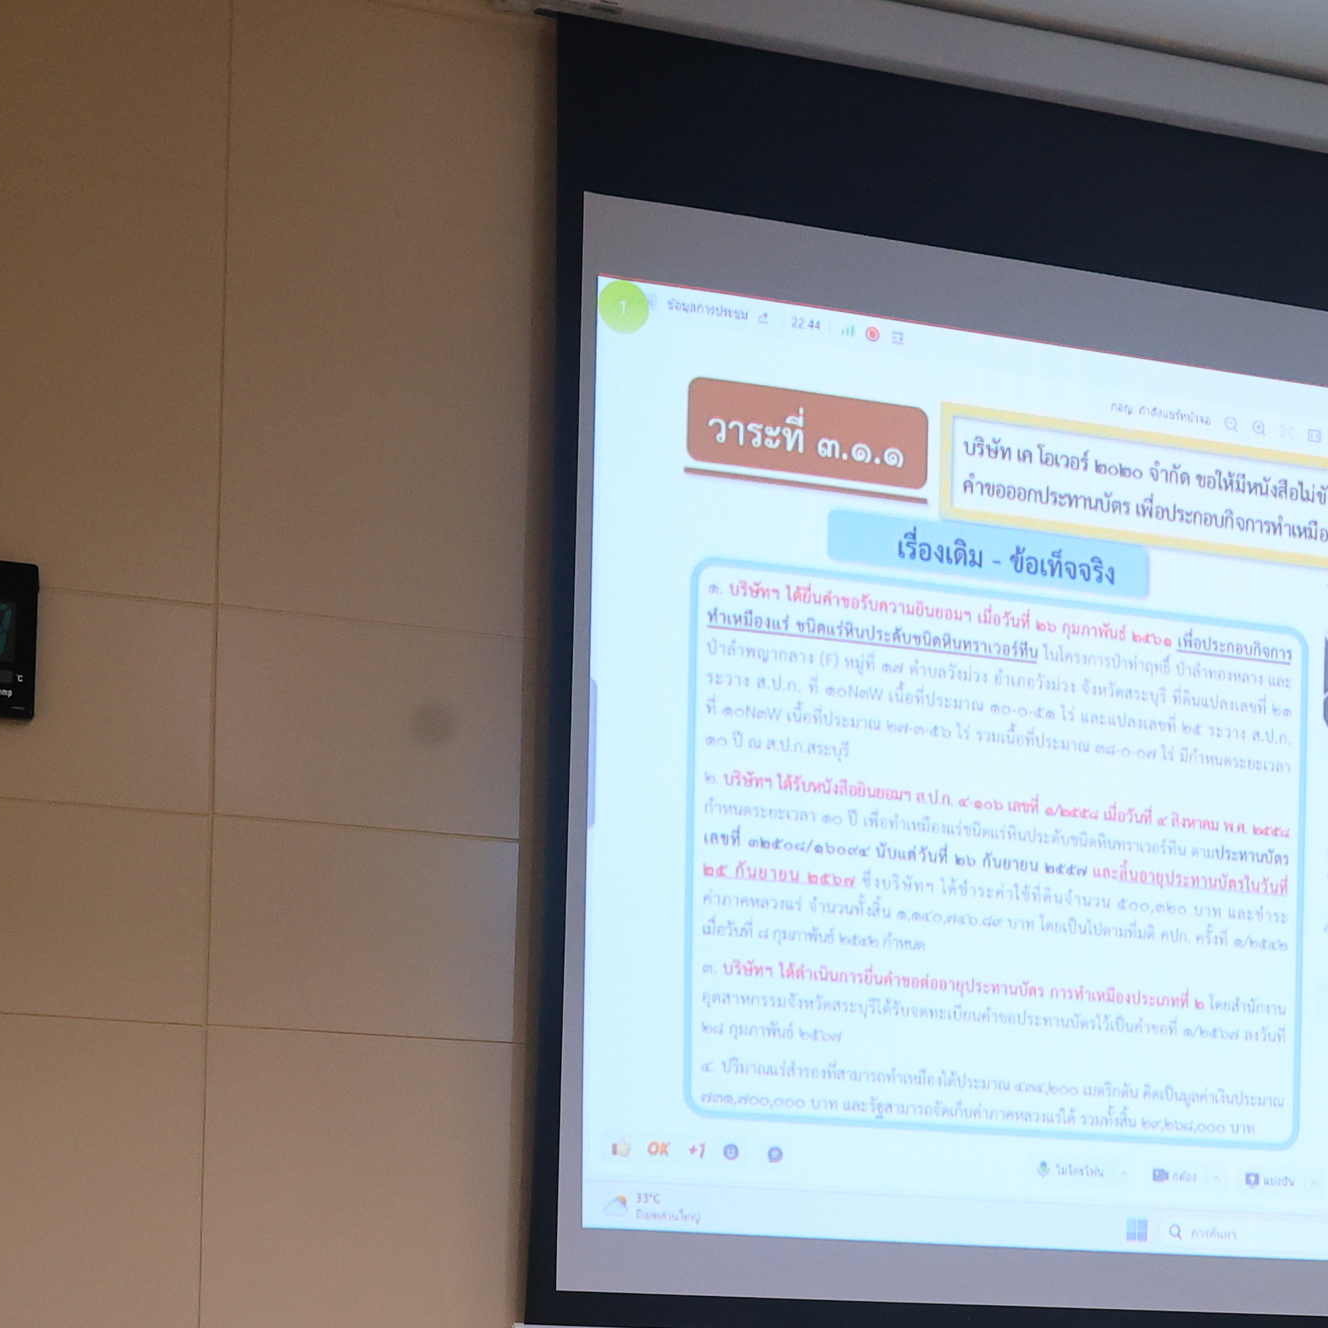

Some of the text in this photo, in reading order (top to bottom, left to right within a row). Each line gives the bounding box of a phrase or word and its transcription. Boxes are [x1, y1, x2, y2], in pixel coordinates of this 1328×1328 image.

[707, 408, 905, 470] วาระที่ ๓.๑.๑
[962, 434, 1012, 461] บริษัท
[1036, 442, 1090, 472] โอเวอร์
[1093, 458, 1144, 480] ๒๐๒๐
[1148, 459, 1191, 487] จำกัด
[962, 471, 1131, 516] คำขอออกประทานบัตร
[897, 525, 983, 569] เรื่องเดิม
[1008, 544, 1115, 586] ข้อเท็จจริง
[706, 606, 790, 632] ทำเหมืองแร่
[1267, 675, 1292, 689] และ
[728, 578, 781, 601] บริษัทฯ
[976, 603, 1031, 630] เมื่อวันที่
[1061, 621, 1127, 642] กุมภาพันธ์
[1176, 627, 1293, 661] เพื่อประกอบกิจการ
[705, 671, 750, 688] ระวาง
[1207, 724, 1246, 741] ระวาง
[843, 650, 876, 676] หมู่ที่
[1081, 677, 1167, 709] จังหวัดสระบุรี
[722, 768, 773, 789] บริษัทฯ
[1007, 792, 1039, 815] เลขที่
[1102, 800, 1153, 826] เมื่อวันที่
[1170, 811, 1220, 832] สิงหาคม
[703, 824, 741, 847] เลขที่
[981, 850, 1039, 873] กันยายน
[1006, 917, 1035, 931] บาท
[1192, 904, 1222, 919] บาท
[722, 958, 774, 978] บริษัทฯ
[809, 1097, 839, 1111] บาท
[1229, 1122, 1255, 1135] บาท
